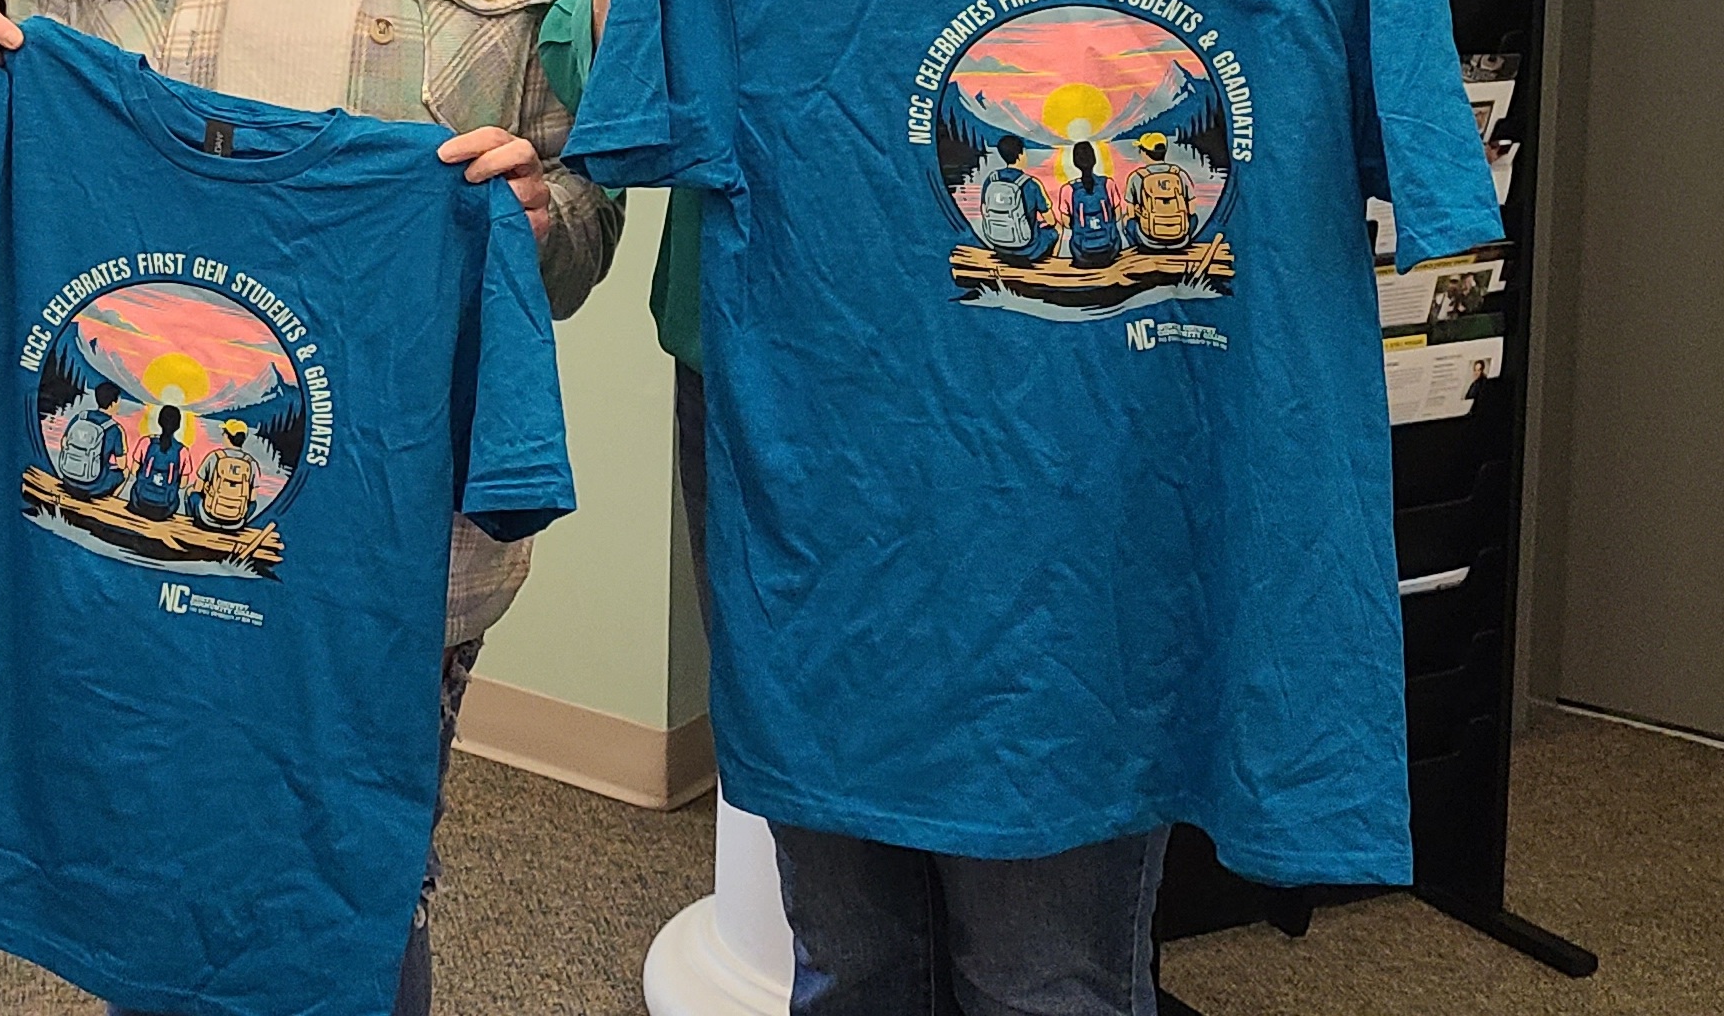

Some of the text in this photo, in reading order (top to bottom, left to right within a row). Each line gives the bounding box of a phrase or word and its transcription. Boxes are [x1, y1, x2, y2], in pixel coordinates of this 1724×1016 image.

[908, 94, 934, 145] NCCC
[1197, 29, 1219, 52] &
[1212, 50, 1254, 162] GRADUATES
[19, 252, 333, 467] NCCC CELEBRATES FIRST GEN STUDENTS & GRADUATES
[1126, 318, 1156, 351] NC
[158, 582, 190, 614] NC
